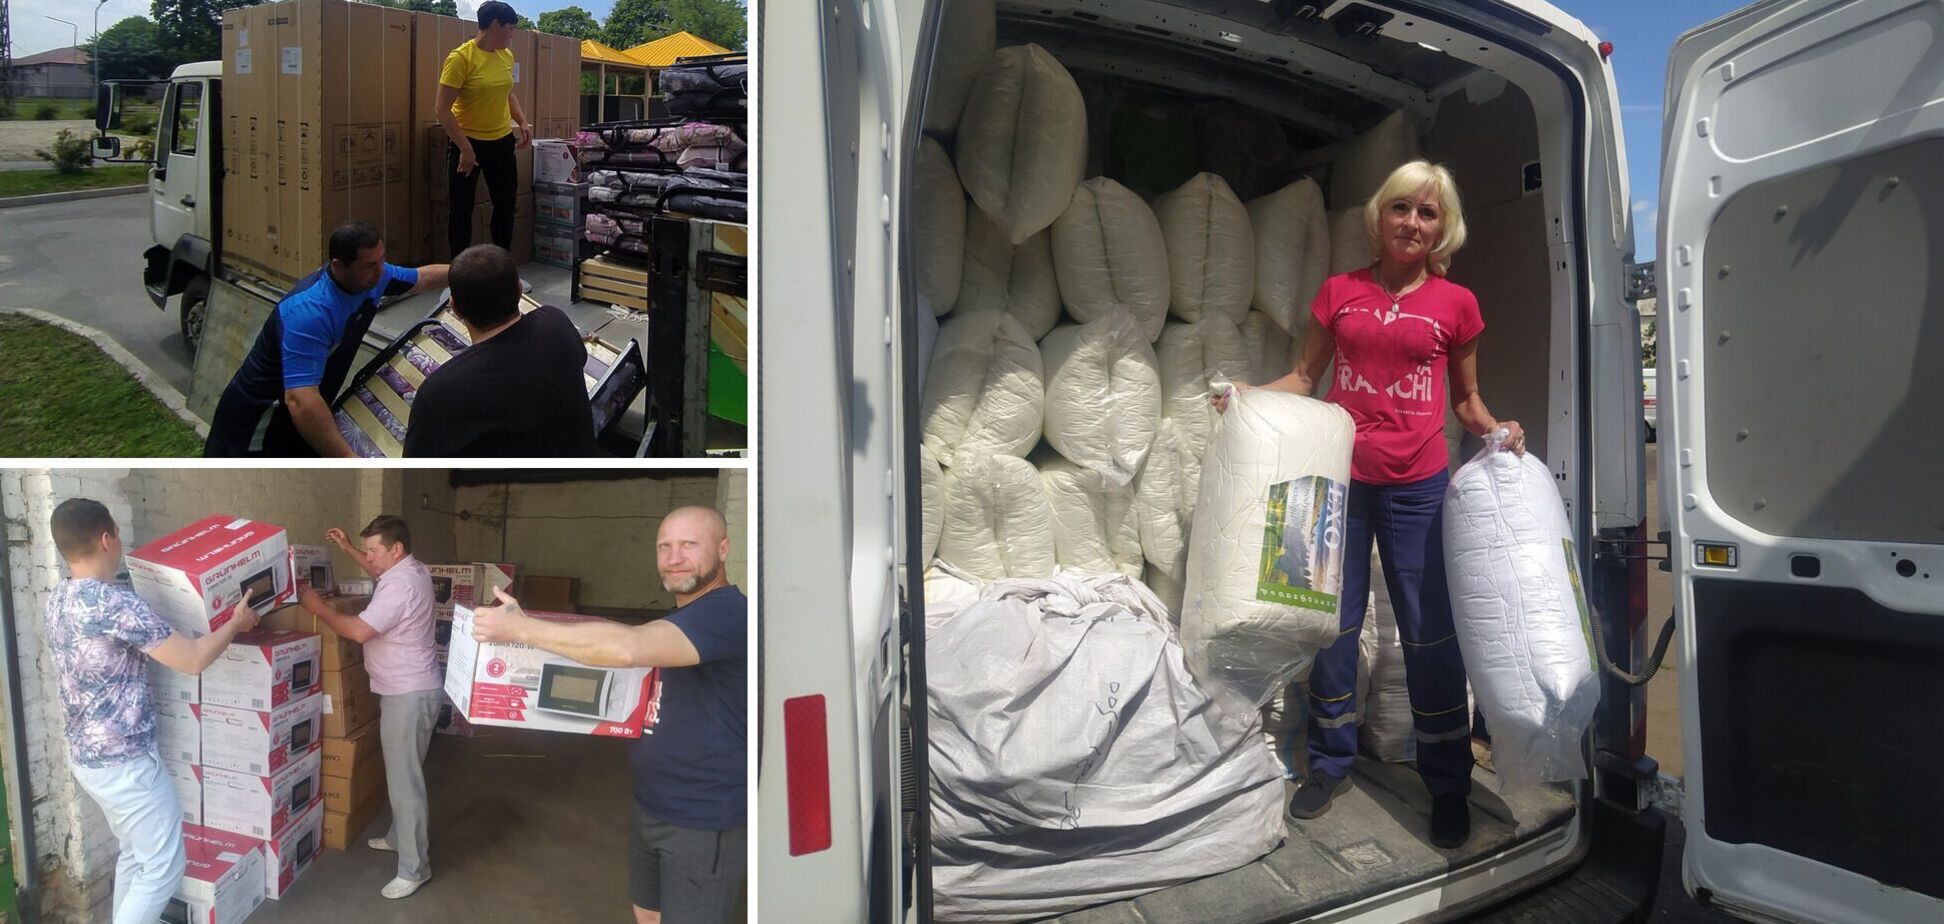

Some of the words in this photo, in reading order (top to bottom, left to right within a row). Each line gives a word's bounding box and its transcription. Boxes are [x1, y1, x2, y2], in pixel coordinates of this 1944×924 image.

[160, 523, 221, 553] GRUNHELM
[204, 549, 261, 586] GRUNHELM
[609, 726, 623, 734] 700
